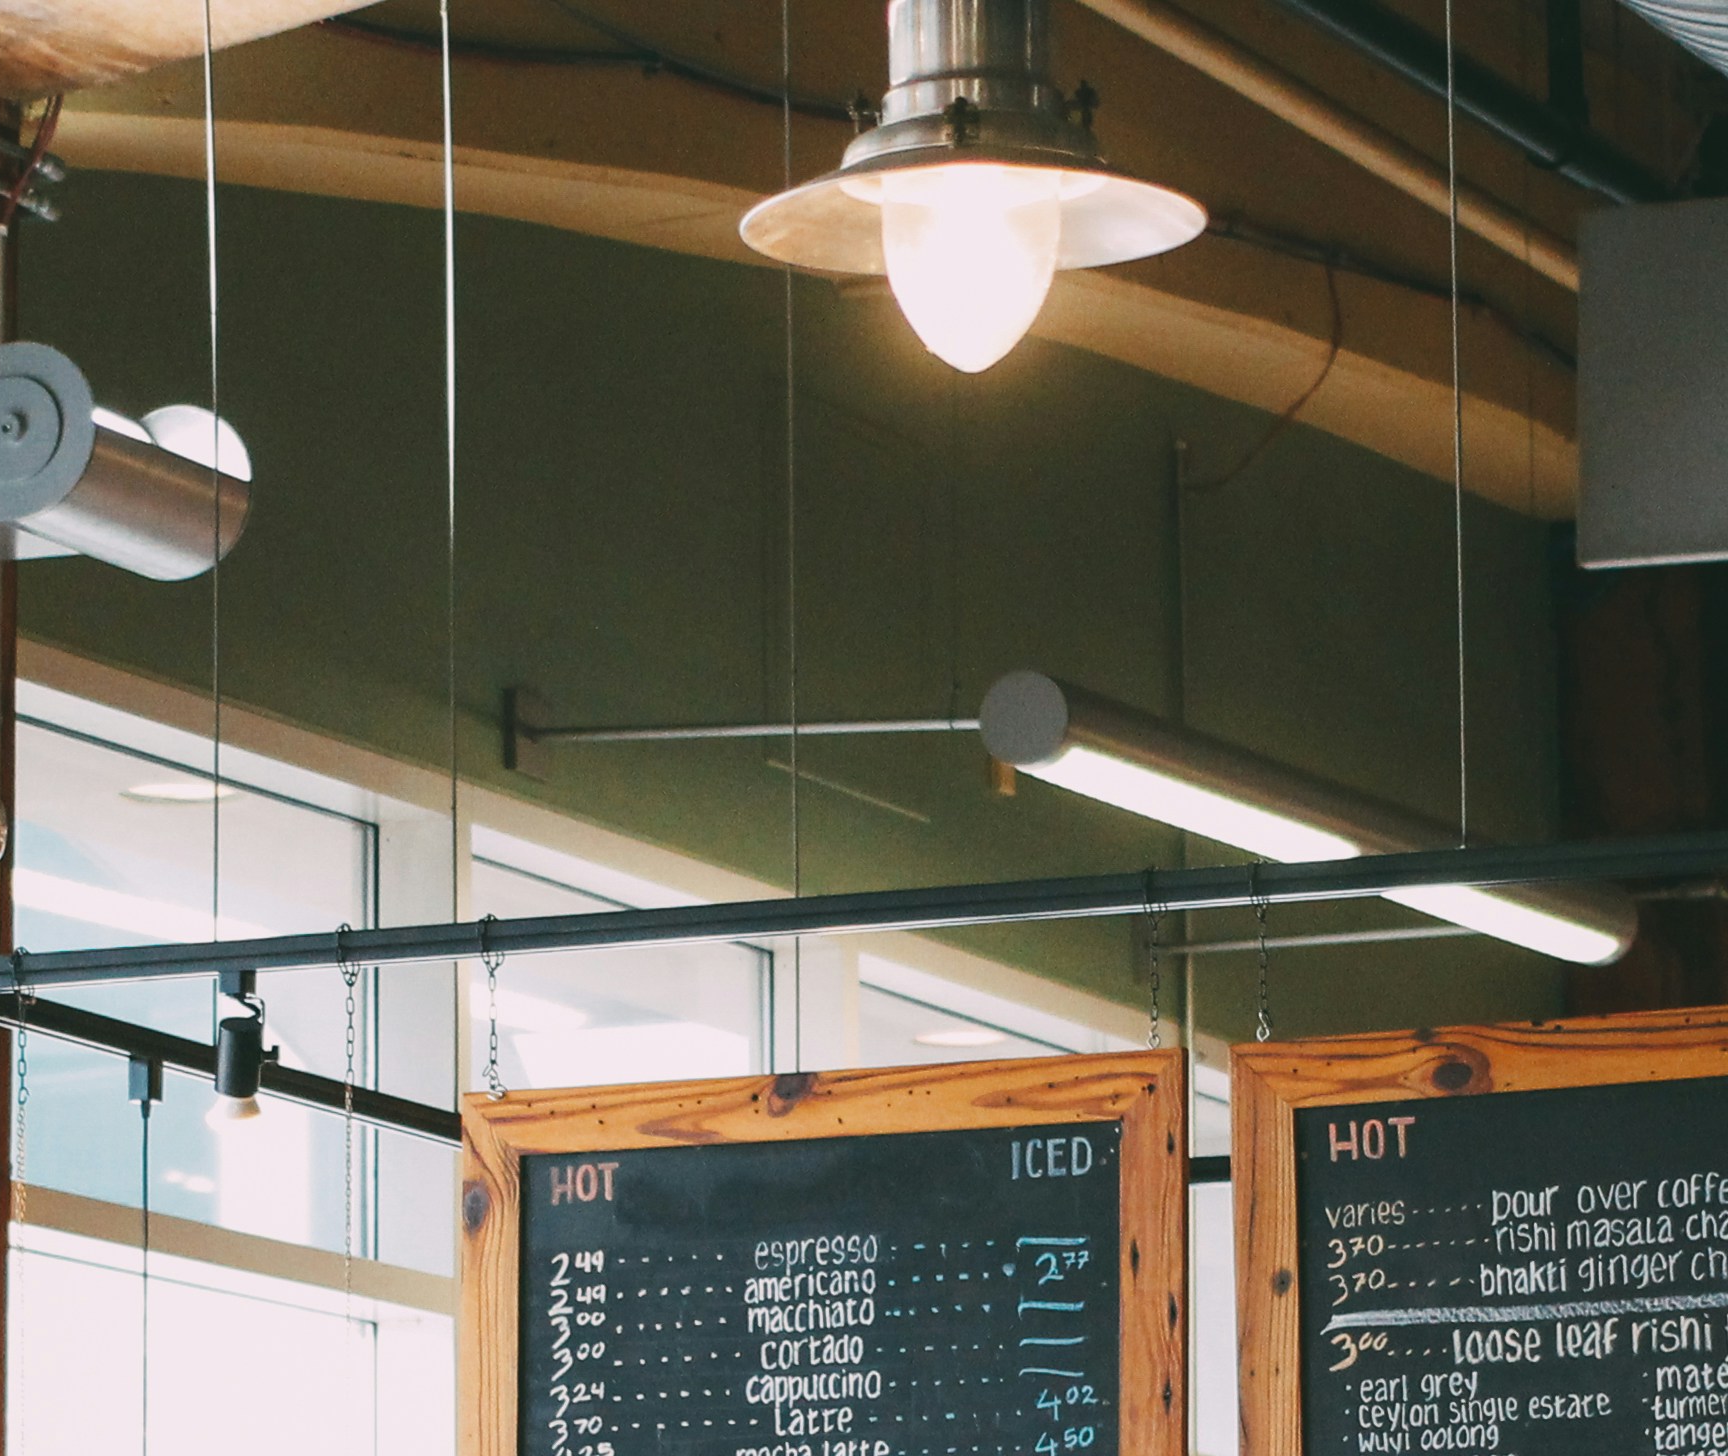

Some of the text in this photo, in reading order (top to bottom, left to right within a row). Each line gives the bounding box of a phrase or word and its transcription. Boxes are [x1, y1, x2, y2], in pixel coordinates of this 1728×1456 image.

[1328, 1116, 1416, 1163] HOT
[549, 1136, 1092, 1206] HOT ICED
[1325, 1200, 1405, 1230] varies
[1491, 1184, 1559, 1226] pour
[1577, 1179, 1647, 1214] over
[754, 1234, 878, 1276] espresso
[1327, 1234, 1385, 1269] 370
[1495, 1221, 1557, 1255] rishi
[1567, 1214, 1673, 1251] masala
[744, 1266, 876, 1304] americano
[1328, 1269, 1385, 1307] 370
[1479, 1257, 1567, 1298] bhakti
[1578, 1248, 1683, 1293] ginger
[747, 1297, 874, 1334] macchiato
[760, 1335, 864, 1370] cortado
[1452, 1327, 1541, 1365] loose
[1556, 1318, 1619, 1359] leaf
[1631, 1314, 1712, 1354] rishi
[745, 1369, 881, 1408] cappuccino
[1359, 1371, 1478, 1403] earl grey
[774, 1406, 853, 1437] latte
[1358, 1392, 1612, 1430] ceylon single estate
[1358, 1424, 1499, 1455] wuyi oolong
